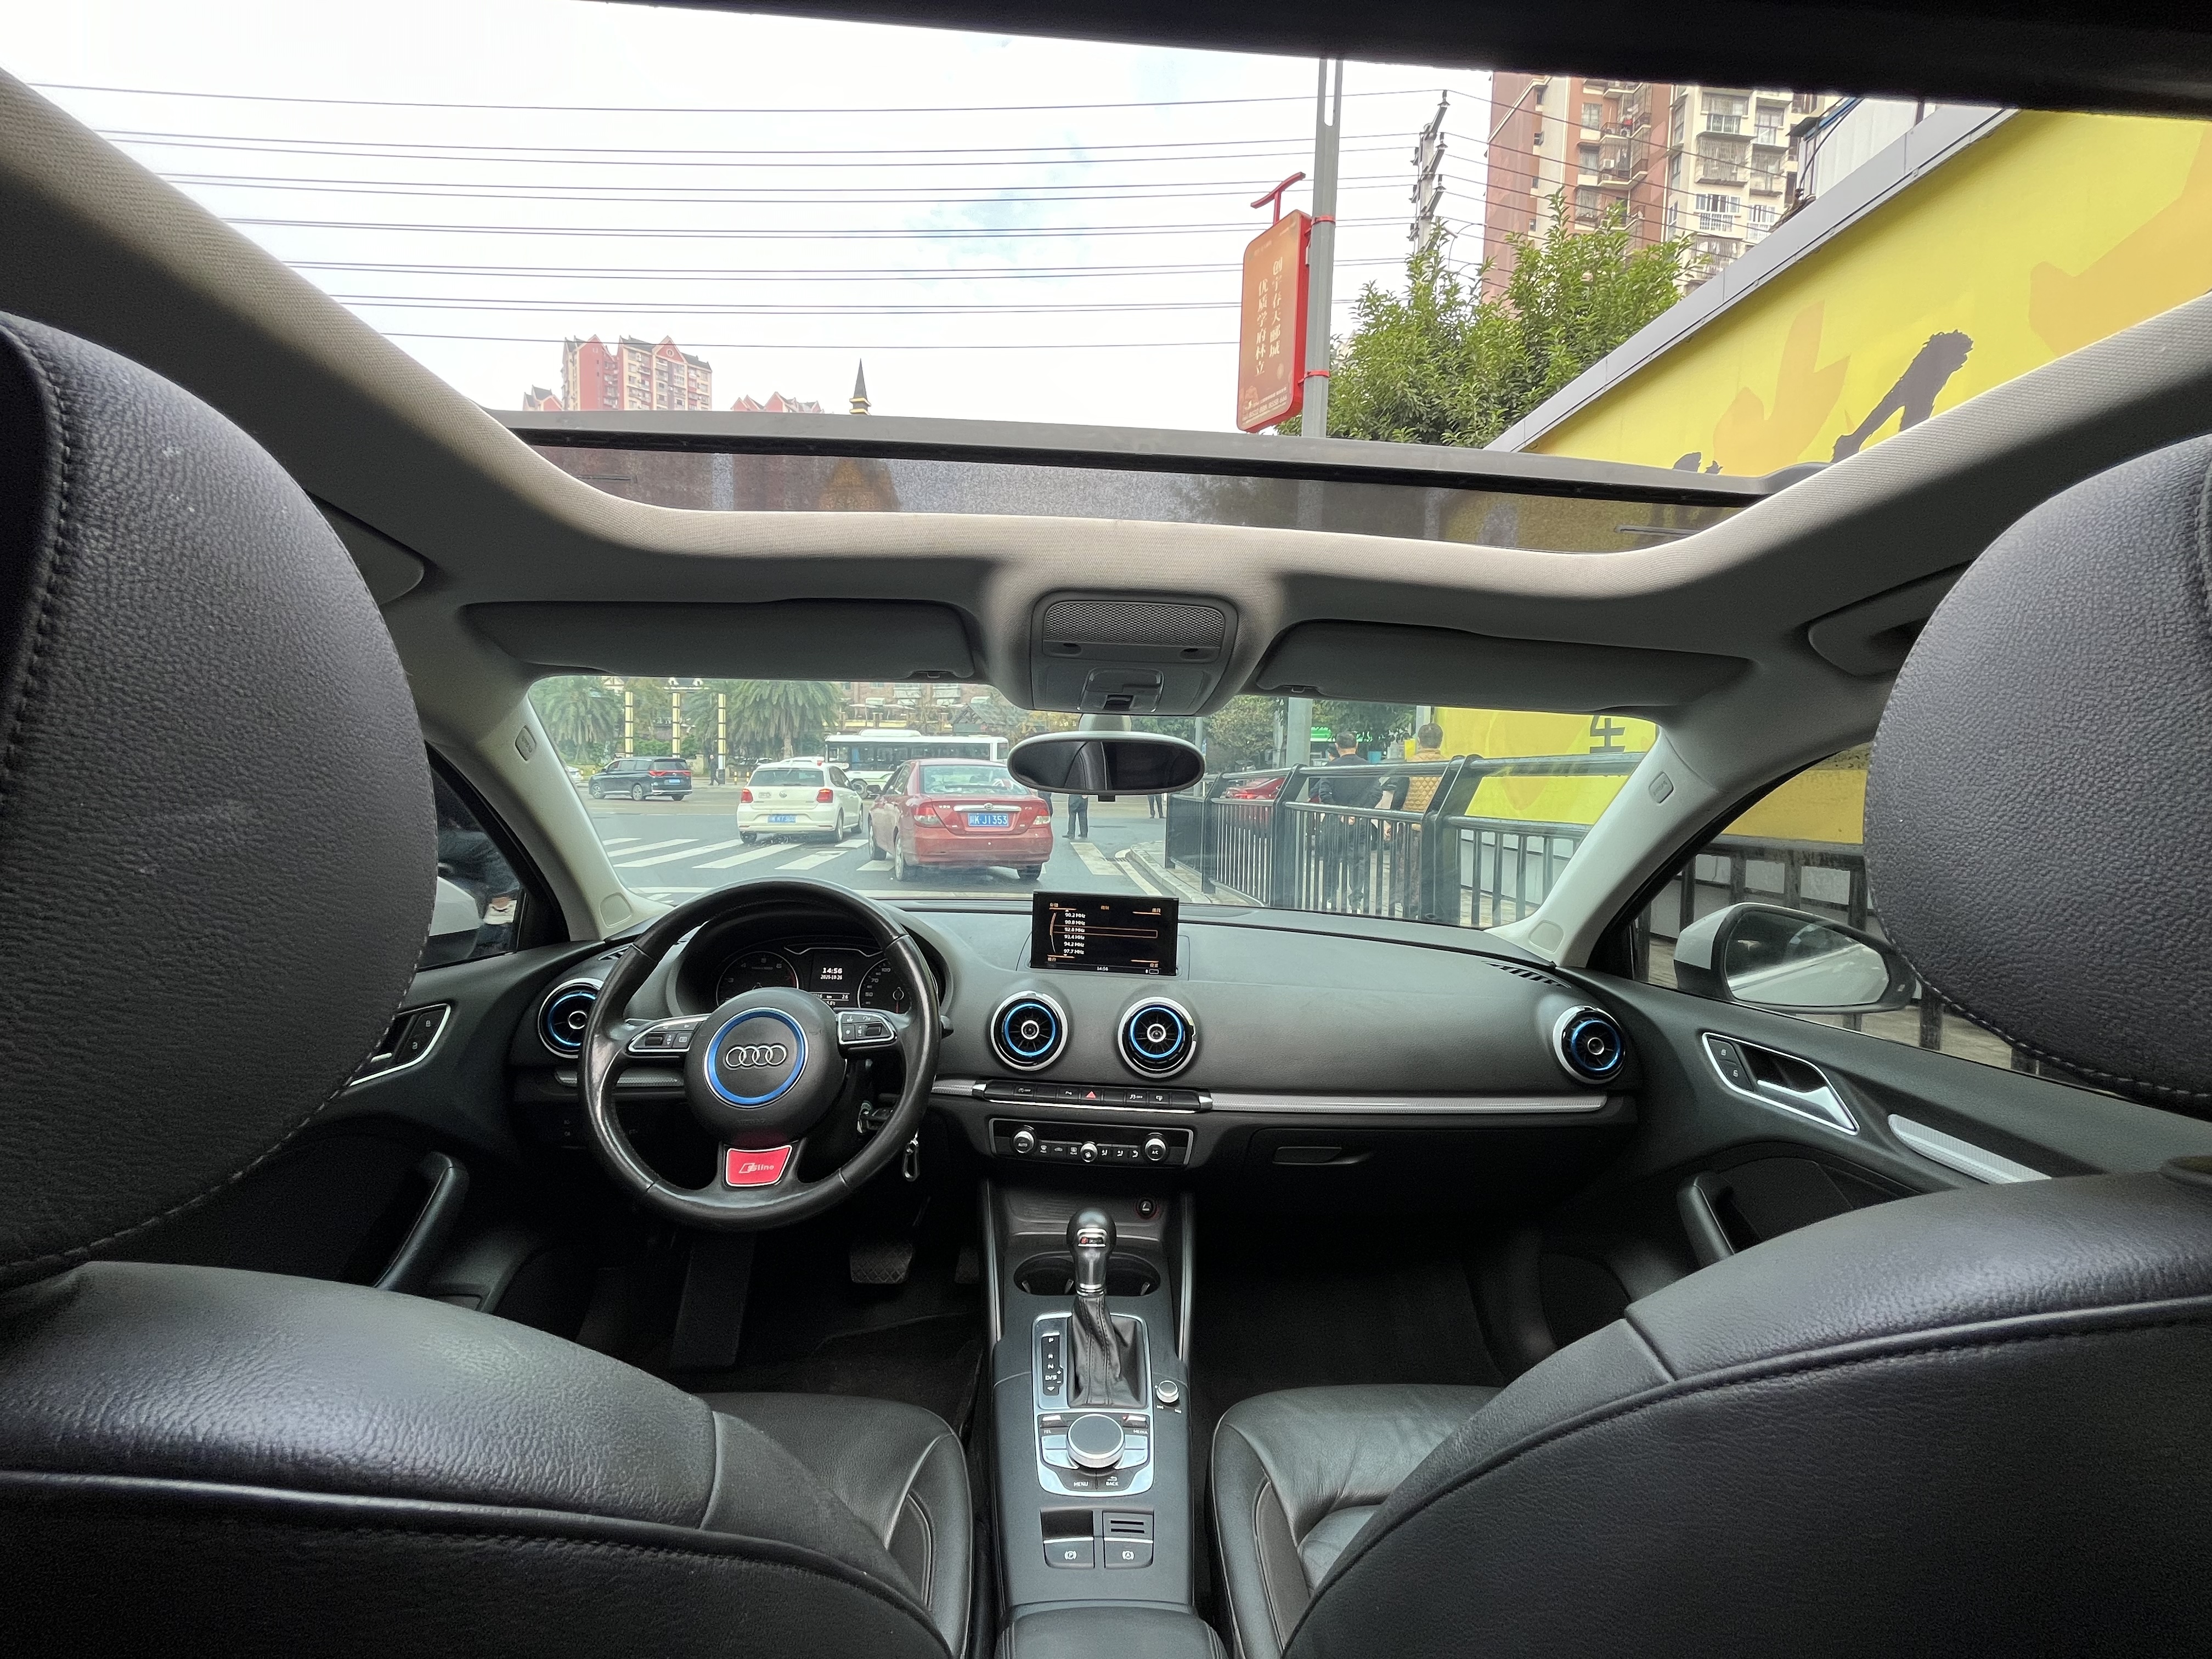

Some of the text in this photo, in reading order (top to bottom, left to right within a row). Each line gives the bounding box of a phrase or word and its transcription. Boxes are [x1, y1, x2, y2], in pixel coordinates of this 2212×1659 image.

[1254, 279, 1268, 377] 优质学府林立
